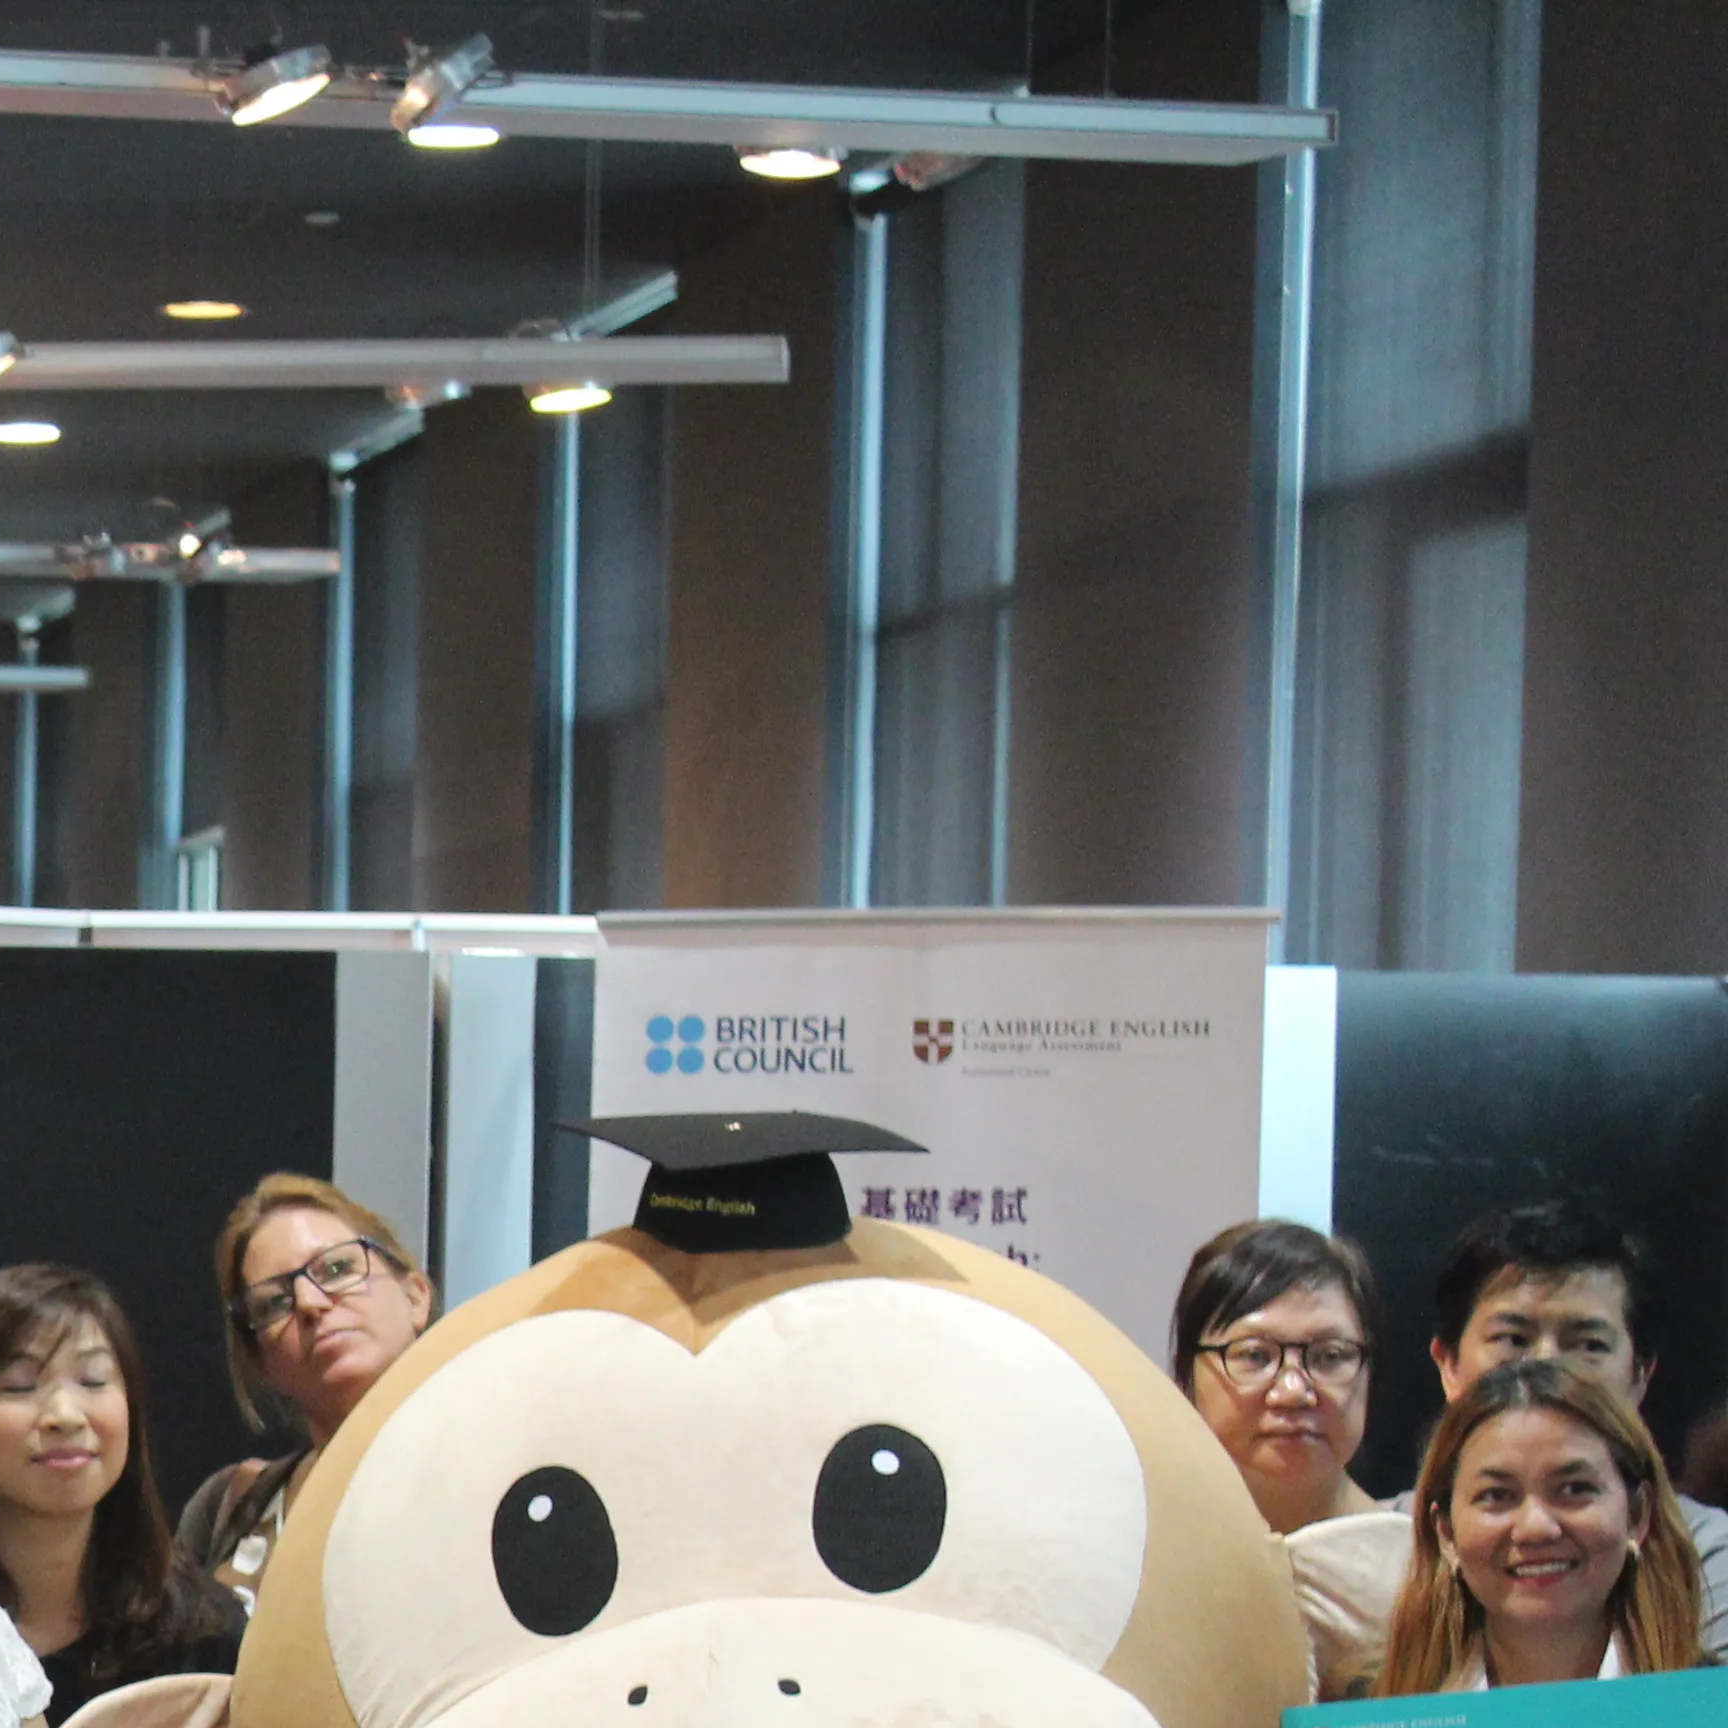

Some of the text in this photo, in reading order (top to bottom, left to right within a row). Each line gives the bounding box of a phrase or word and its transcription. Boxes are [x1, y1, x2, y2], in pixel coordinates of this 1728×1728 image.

[716, 1016, 846, 1043] BRITISH
[961, 1018, 1211, 1038] CAMBRIDGE ENGLISH
[714, 1046, 853, 1075] COUNCIL
[861, 1186, 1029, 1226] 基礎考試
